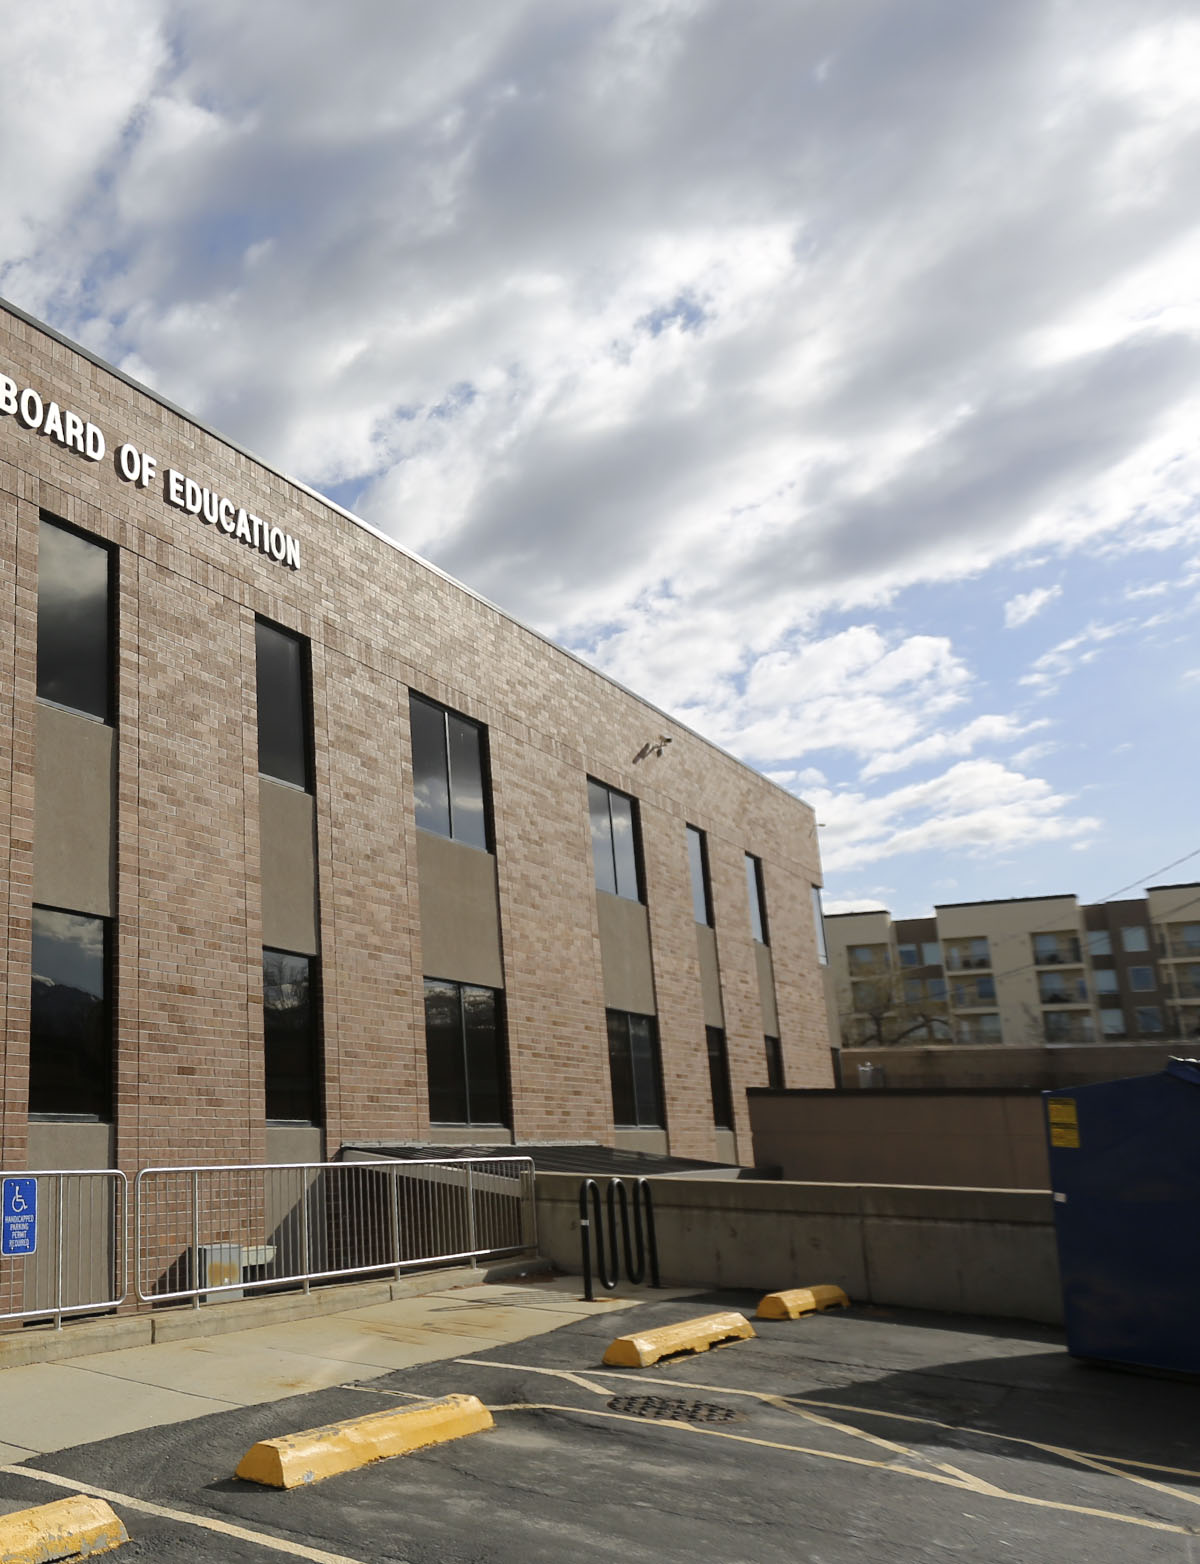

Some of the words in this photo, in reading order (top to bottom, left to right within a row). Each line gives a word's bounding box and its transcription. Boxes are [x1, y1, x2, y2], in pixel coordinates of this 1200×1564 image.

[119, 443, 157, 488] OF
[168, 467, 300, 571] EDUCATION
[5, 1215, 34, 1223] HANDICAPPED
[8, 1239, 30, 1247] REQUIRED
